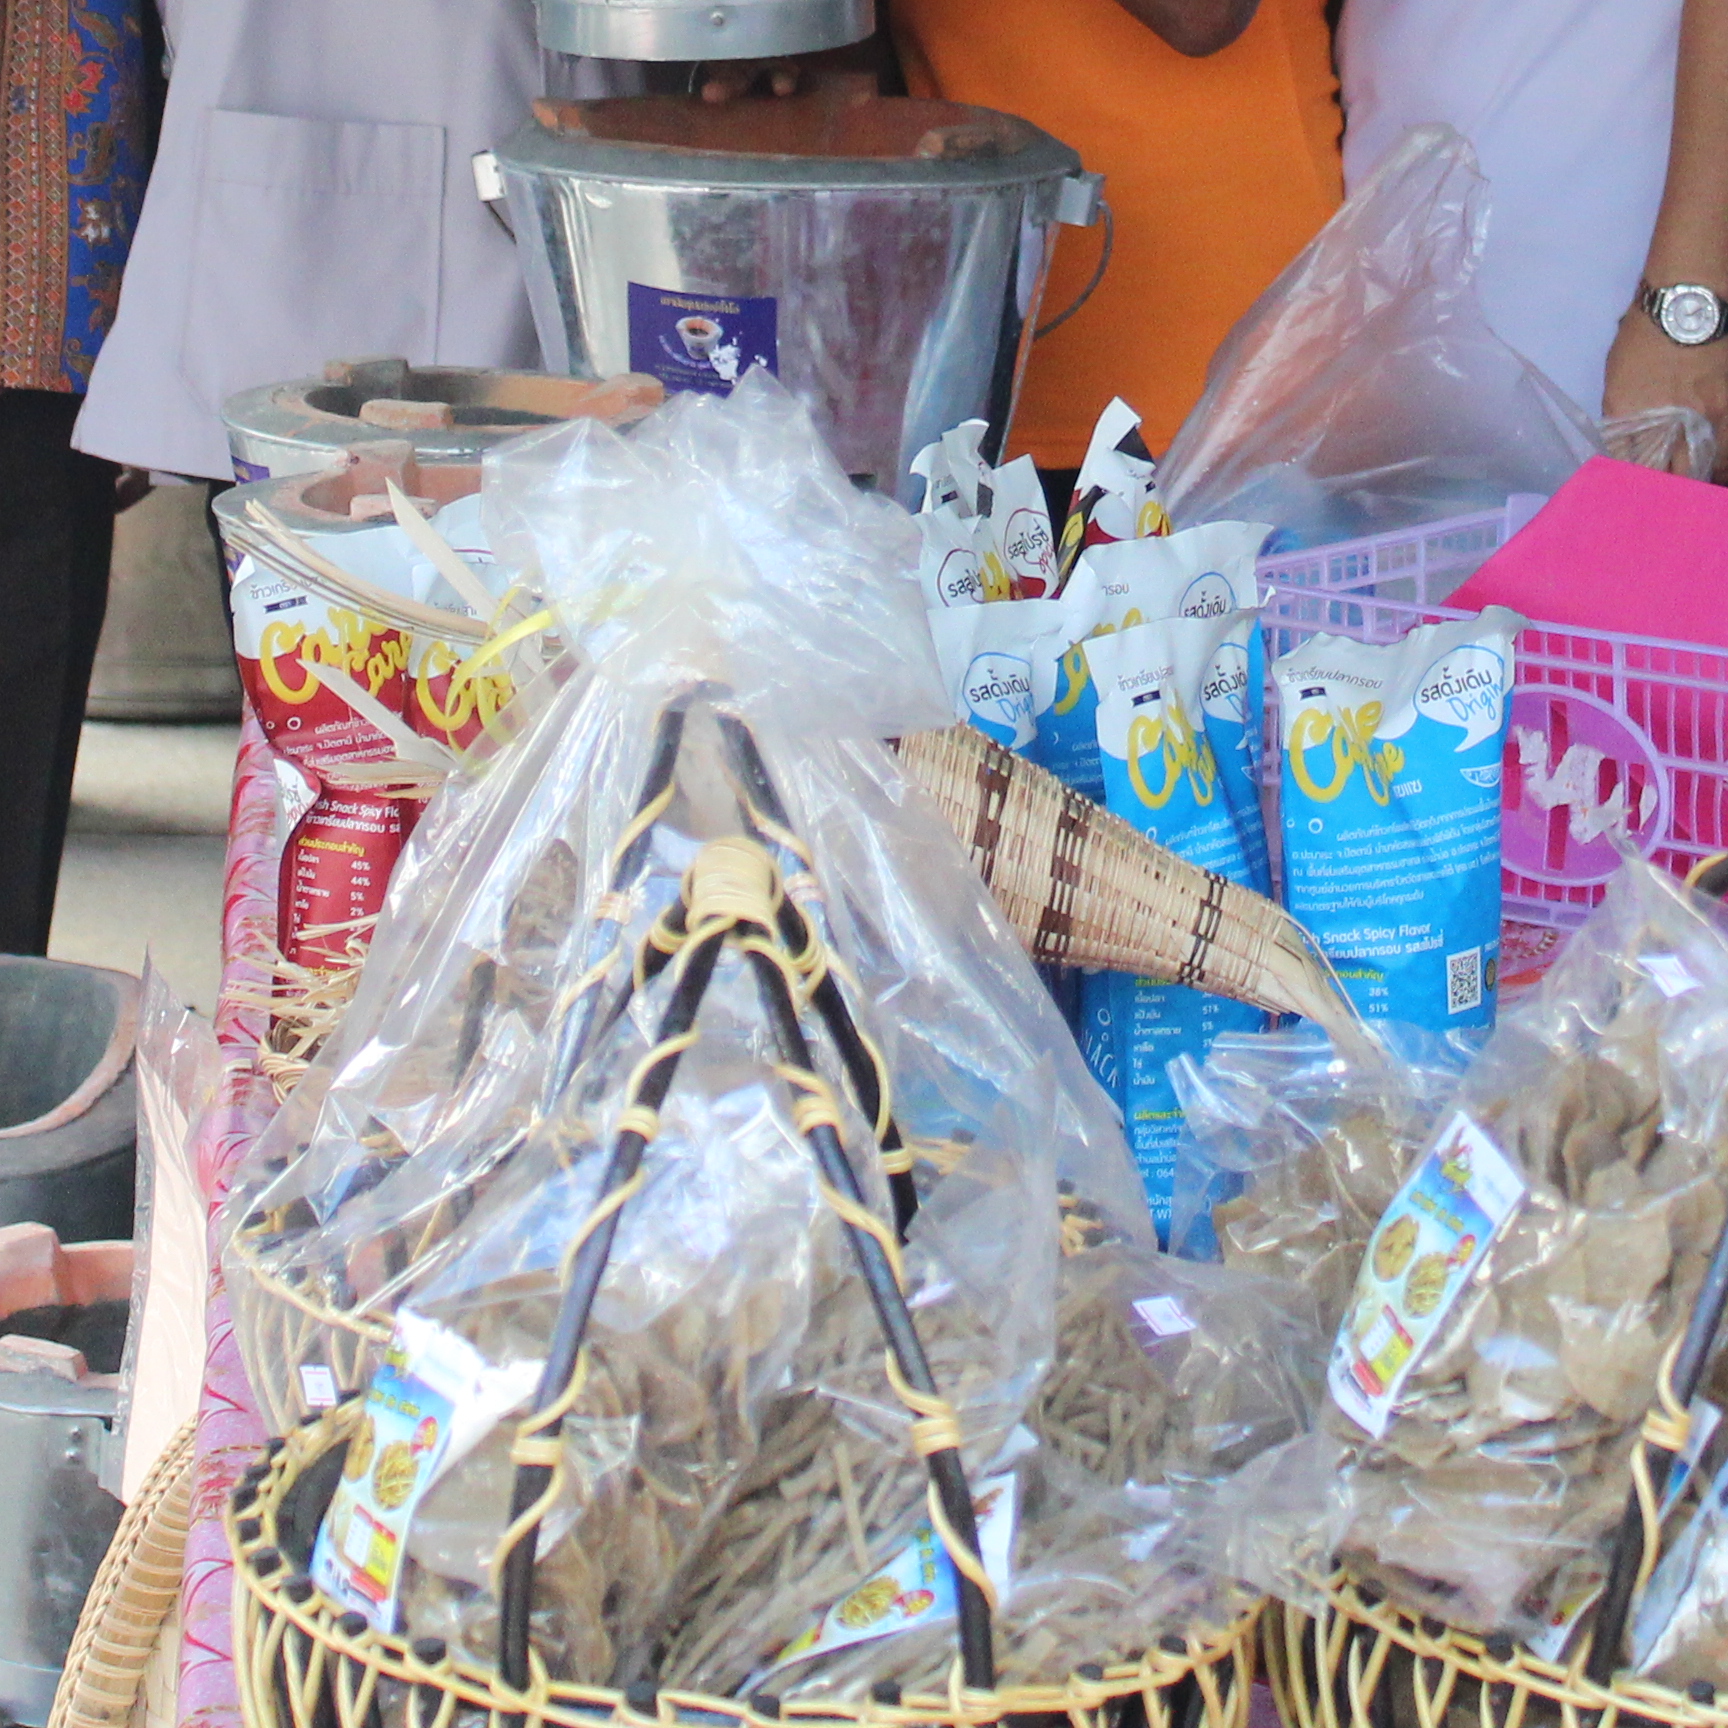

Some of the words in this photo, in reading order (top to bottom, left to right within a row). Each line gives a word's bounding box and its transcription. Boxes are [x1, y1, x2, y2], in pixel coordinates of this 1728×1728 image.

[330, 800, 358, 815] Snack
[350, 860, 371, 871] 45%
[350, 875, 371, 887] 44%
[350, 891, 365, 902] 5%
[1323, 928, 1362, 944] Snack
[1363, 926, 1396, 943] Spicy
[1399, 923, 1432, 938] Flavor
